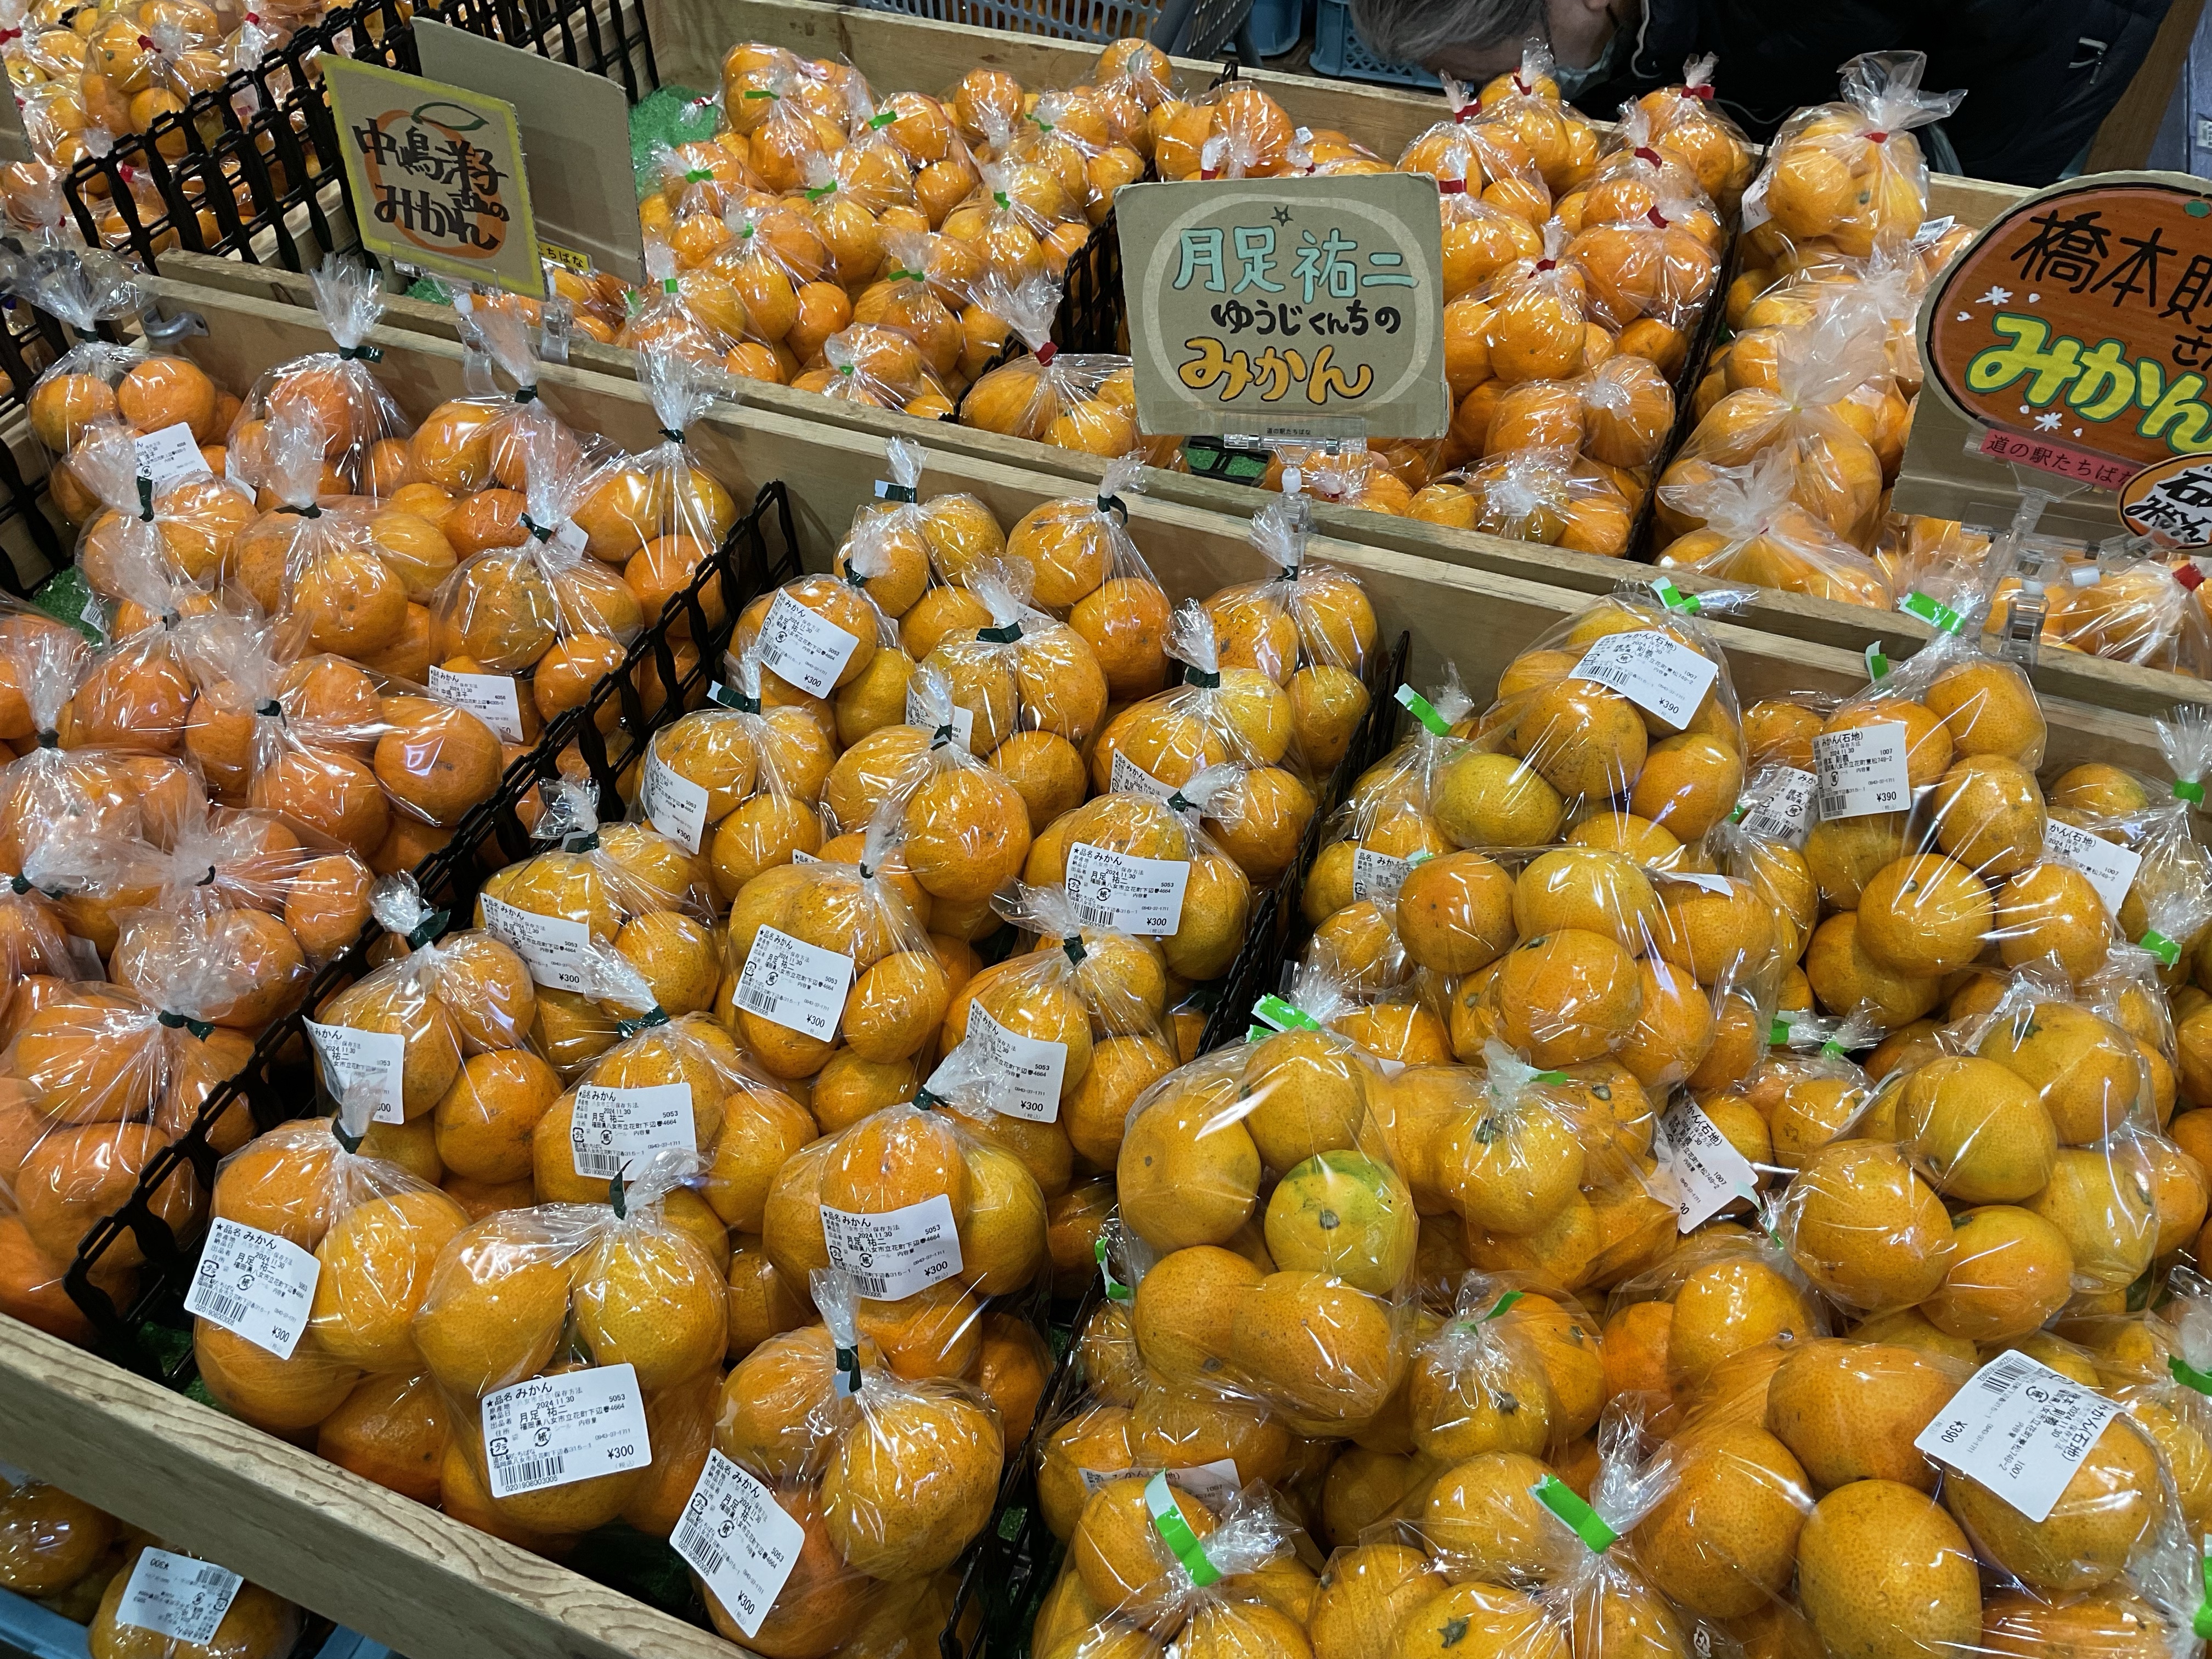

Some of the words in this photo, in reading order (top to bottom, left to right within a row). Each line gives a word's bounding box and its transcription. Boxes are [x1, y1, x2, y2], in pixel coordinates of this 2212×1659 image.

[374, 182, 501, 250] みかん
[1173, 226, 1420, 304] 月足祐二
[1211, 299, 1402, 336] ゆうじくんちの
[1178, 337, 1374, 405] みかん
[1965, 313, 2212, 455] みかん
[1267, 427, 1311, 436] 道の駅たちばな
[785, 600, 805, 617] みかん
[1623, 633, 1677, 651] みかん(石地)
[828, 647, 840, 656] 5053
[441, 673, 459, 682] みかん
[804, 674, 822, 687] ¥300
[1684, 670, 1697, 680] 1007
[1659, 697, 1679, 714] ¥390
[1821, 731, 1863, 747] みかん(石地)
[1127, 764, 1145, 781] みかん
[686, 800, 696, 809] 5053
[1876, 792, 1897, 802] ¥390
[677, 827, 691, 842] ¥300
[2049, 838, 2080, 854] 2024.11.30
[1074, 855, 1089, 864] 原産地
[1080, 848, 1093, 859] 品名
[1094, 853, 1122, 866] みかん
[1359, 853, 1371, 861] 品名
[1071, 866, 1086, 874] 出品者
[1091, 871, 1106, 881] 月足
[1112, 875, 1128, 884] 祐二
[1106, 869, 1136, 879] 2024.11.30
[2104, 867, 2119, 876] 1007
[501, 906, 524, 920] みかん
[1147, 918, 1166, 926] ¥300
[764, 930, 774, 941] 品名
[774, 935, 793, 949] みかん
[778, 952, 802, 966] 2024.11.30
[791, 951, 810, 963] 保存方法
[768, 954, 777, 964] 月足
[781, 960, 795, 970] 祐二
[825, 976, 838, 985] 5053
[559, 973, 579, 983] ¥300
[806, 1014, 825, 1028] ¥300
[983, 1014, 998, 1035] みかん
[315, 1028, 342, 1040] みかん
[583, 1090, 590, 1099] 品名
[592, 1091, 616, 1101] みかん
[1020, 1101, 1043, 1111] ¥300
[592, 1113, 604, 1122] 月足
[610, 1114, 625, 1122] 祐二
[1685, 1101, 1723, 1147] みかん(石地)
[1714, 1171, 1726, 1185] 1007
[828, 1212, 840, 1222] 品名
[843, 1216, 871, 1227] みかん
[223, 1225, 241, 1238] 品名
[244, 1232, 276, 1249] みかん
[848, 1235, 861, 1245] 月足
[867, 1237, 887, 1246] 祐二
[925, 1224, 940, 1235] 5053
[211, 1245, 231, 1256] 出品者
[236, 1252, 254, 1265] 月足
[260, 1262, 276, 1274] 祐二
[212, 1254, 225, 1263] 住所
[214, 1238, 234, 1248] 納品日
[255, 1252, 285, 1269] 2024.11.30
[897, 1249, 915, 1257] 内容量
[913, 1250, 945, 1266] 0943-37-1711
[924, 1261, 948, 1277] ¥300
[272, 1325, 290, 1342] ¥300
[489, 1403, 511, 1414] 原産地
[555, 1387, 583, 1397] 保存方法
[495, 1392, 512, 1406] 品名
[516, 1382, 552, 1399] みかん
[490, 1410, 511, 1420] 納品日
[537, 1396, 574, 1409] 2024.11.30
[491, 1419, 512, 1429] 出品者
[520, 1410, 540, 1422] 月足
[548, 1405, 568, 1417] 祐二
[609, 1393, 625, 1402] 5053
[579, 1417, 597, 1426] 内容量
[595, 1428, 630, 1440] 0943-37-1711
[1940, 1420, 1968, 1443] ¥390
[2063, 1402, 2113, 1463] みかん(石地)
[607, 1444, 634, 1459] ¥300
[2012, 1460, 2025, 1480] 1007
[506, 1476, 558, 1491] 0201908003005
[717, 1459, 731, 1476] 品名
[732, 1471, 760, 1498] みかん
[740, 1497, 761, 1523] 2024.11.30
[723, 1493, 740, 1511] 月足
[771, 1547, 785, 1562] 5053
[738, 1590, 755, 1615] ¥300
